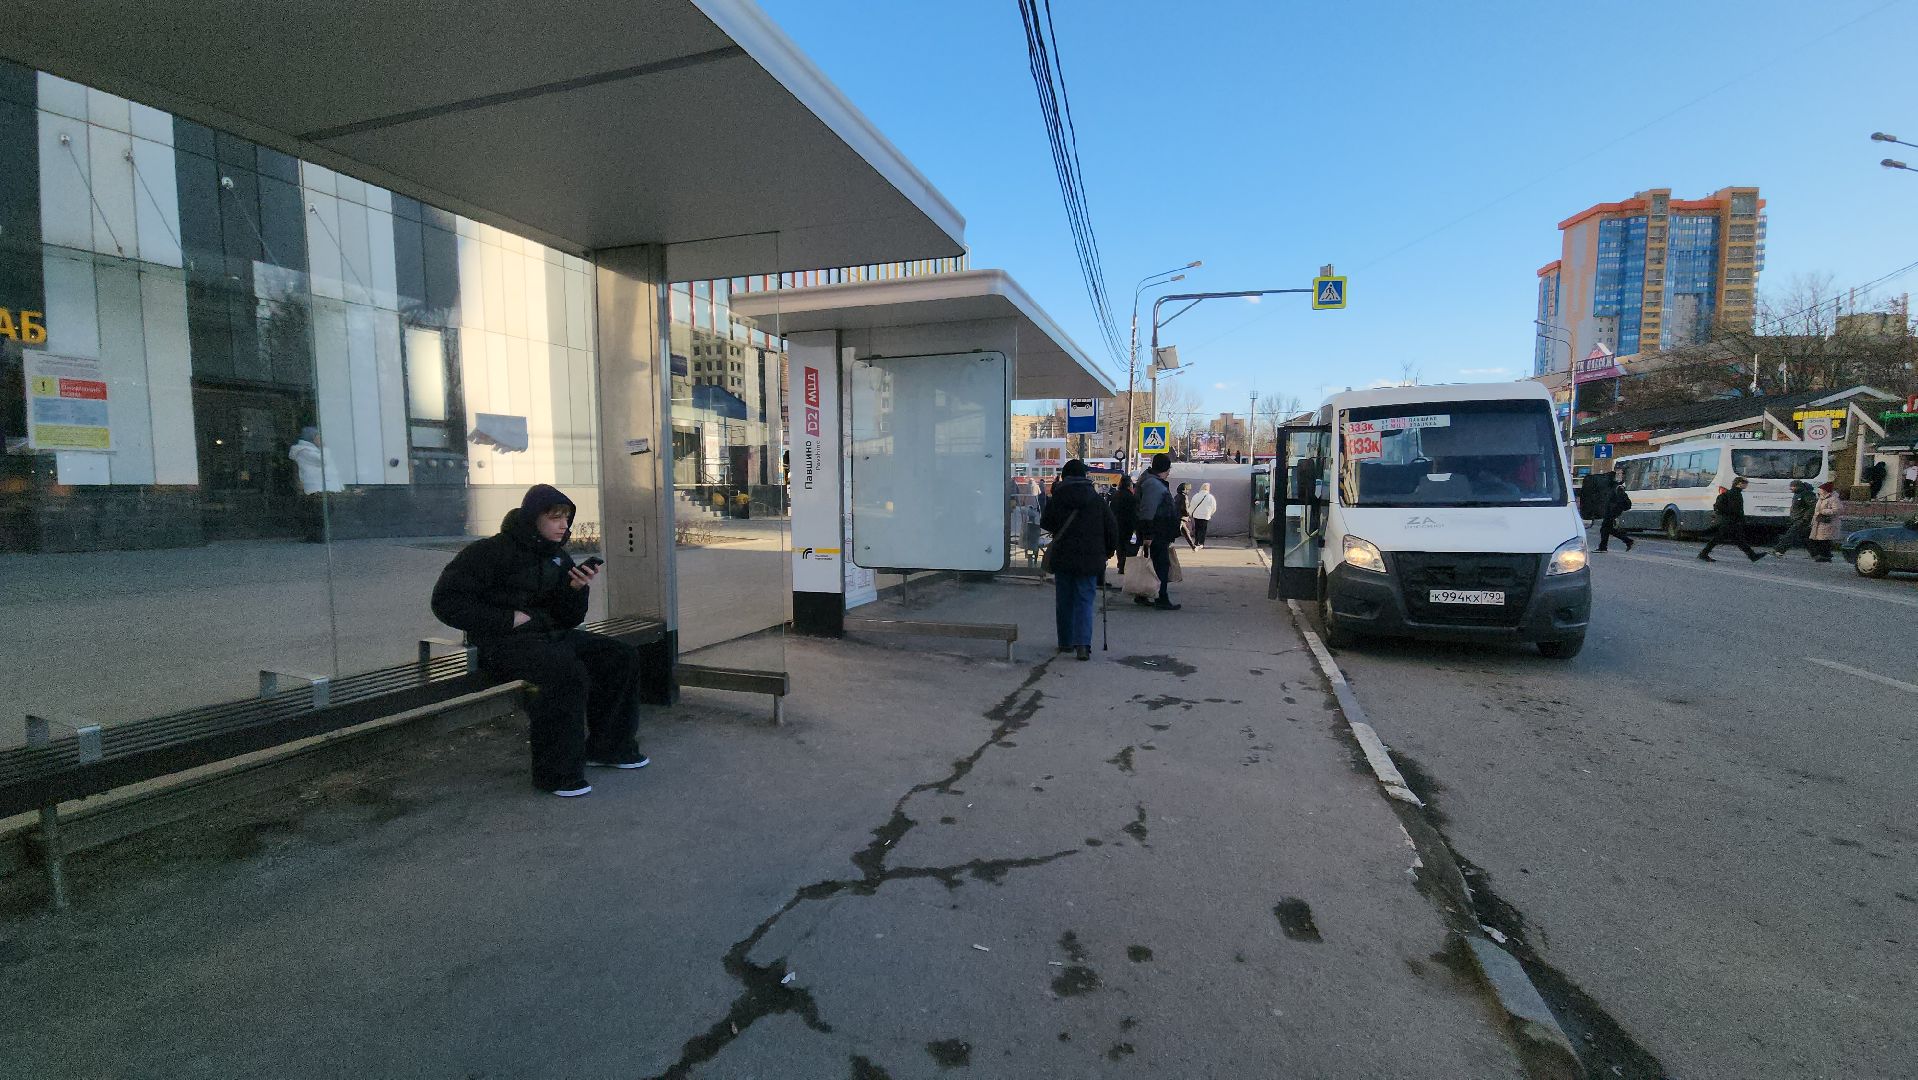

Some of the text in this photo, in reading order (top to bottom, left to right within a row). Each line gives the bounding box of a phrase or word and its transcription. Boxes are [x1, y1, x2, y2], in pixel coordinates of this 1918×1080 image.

[805, 372, 818, 490] Павшино D2 МЦД
[1811, 428, 1824, 436] 40
[1407, 516, 1436, 525] ZA
[1434, 591, 1501, 603] К994КХ 790
